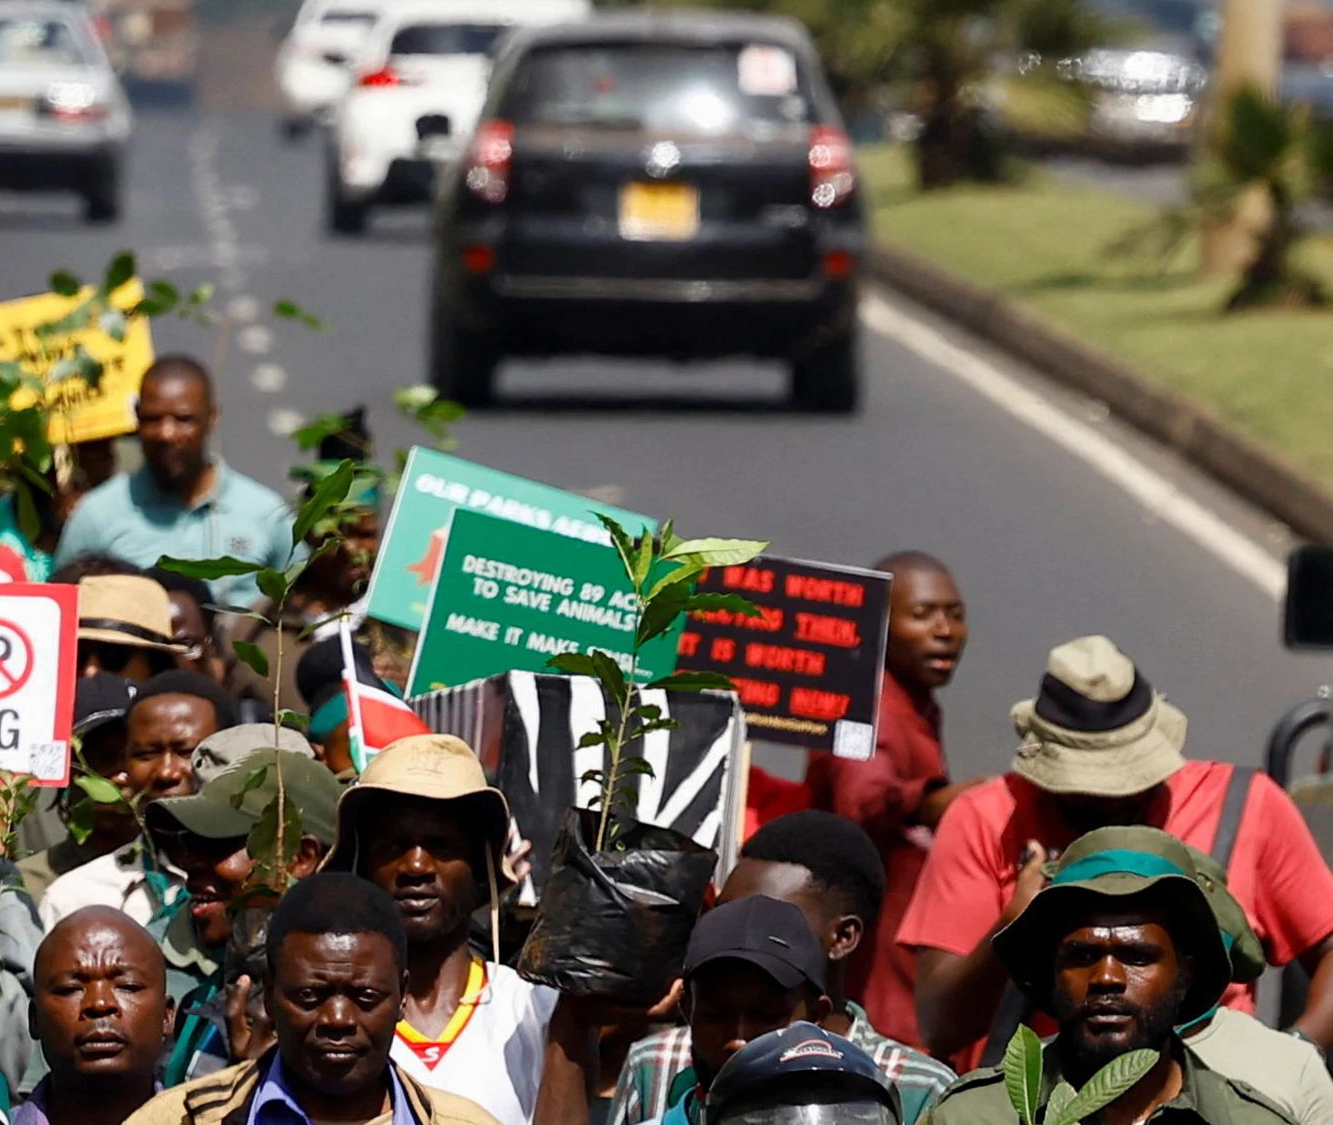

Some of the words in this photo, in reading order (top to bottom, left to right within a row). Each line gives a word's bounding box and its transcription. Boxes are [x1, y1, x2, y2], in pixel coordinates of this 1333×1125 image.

[461, 554, 575, 597] DESTROYING
[579, 581, 606, 603] 89
[472, 577, 500, 600] TO
[503, 585, 553, 613] SAVE
[444, 612, 501, 642] MAKE
[503, 625, 524, 646] IT
[525, 631, 580, 656] MAKE
